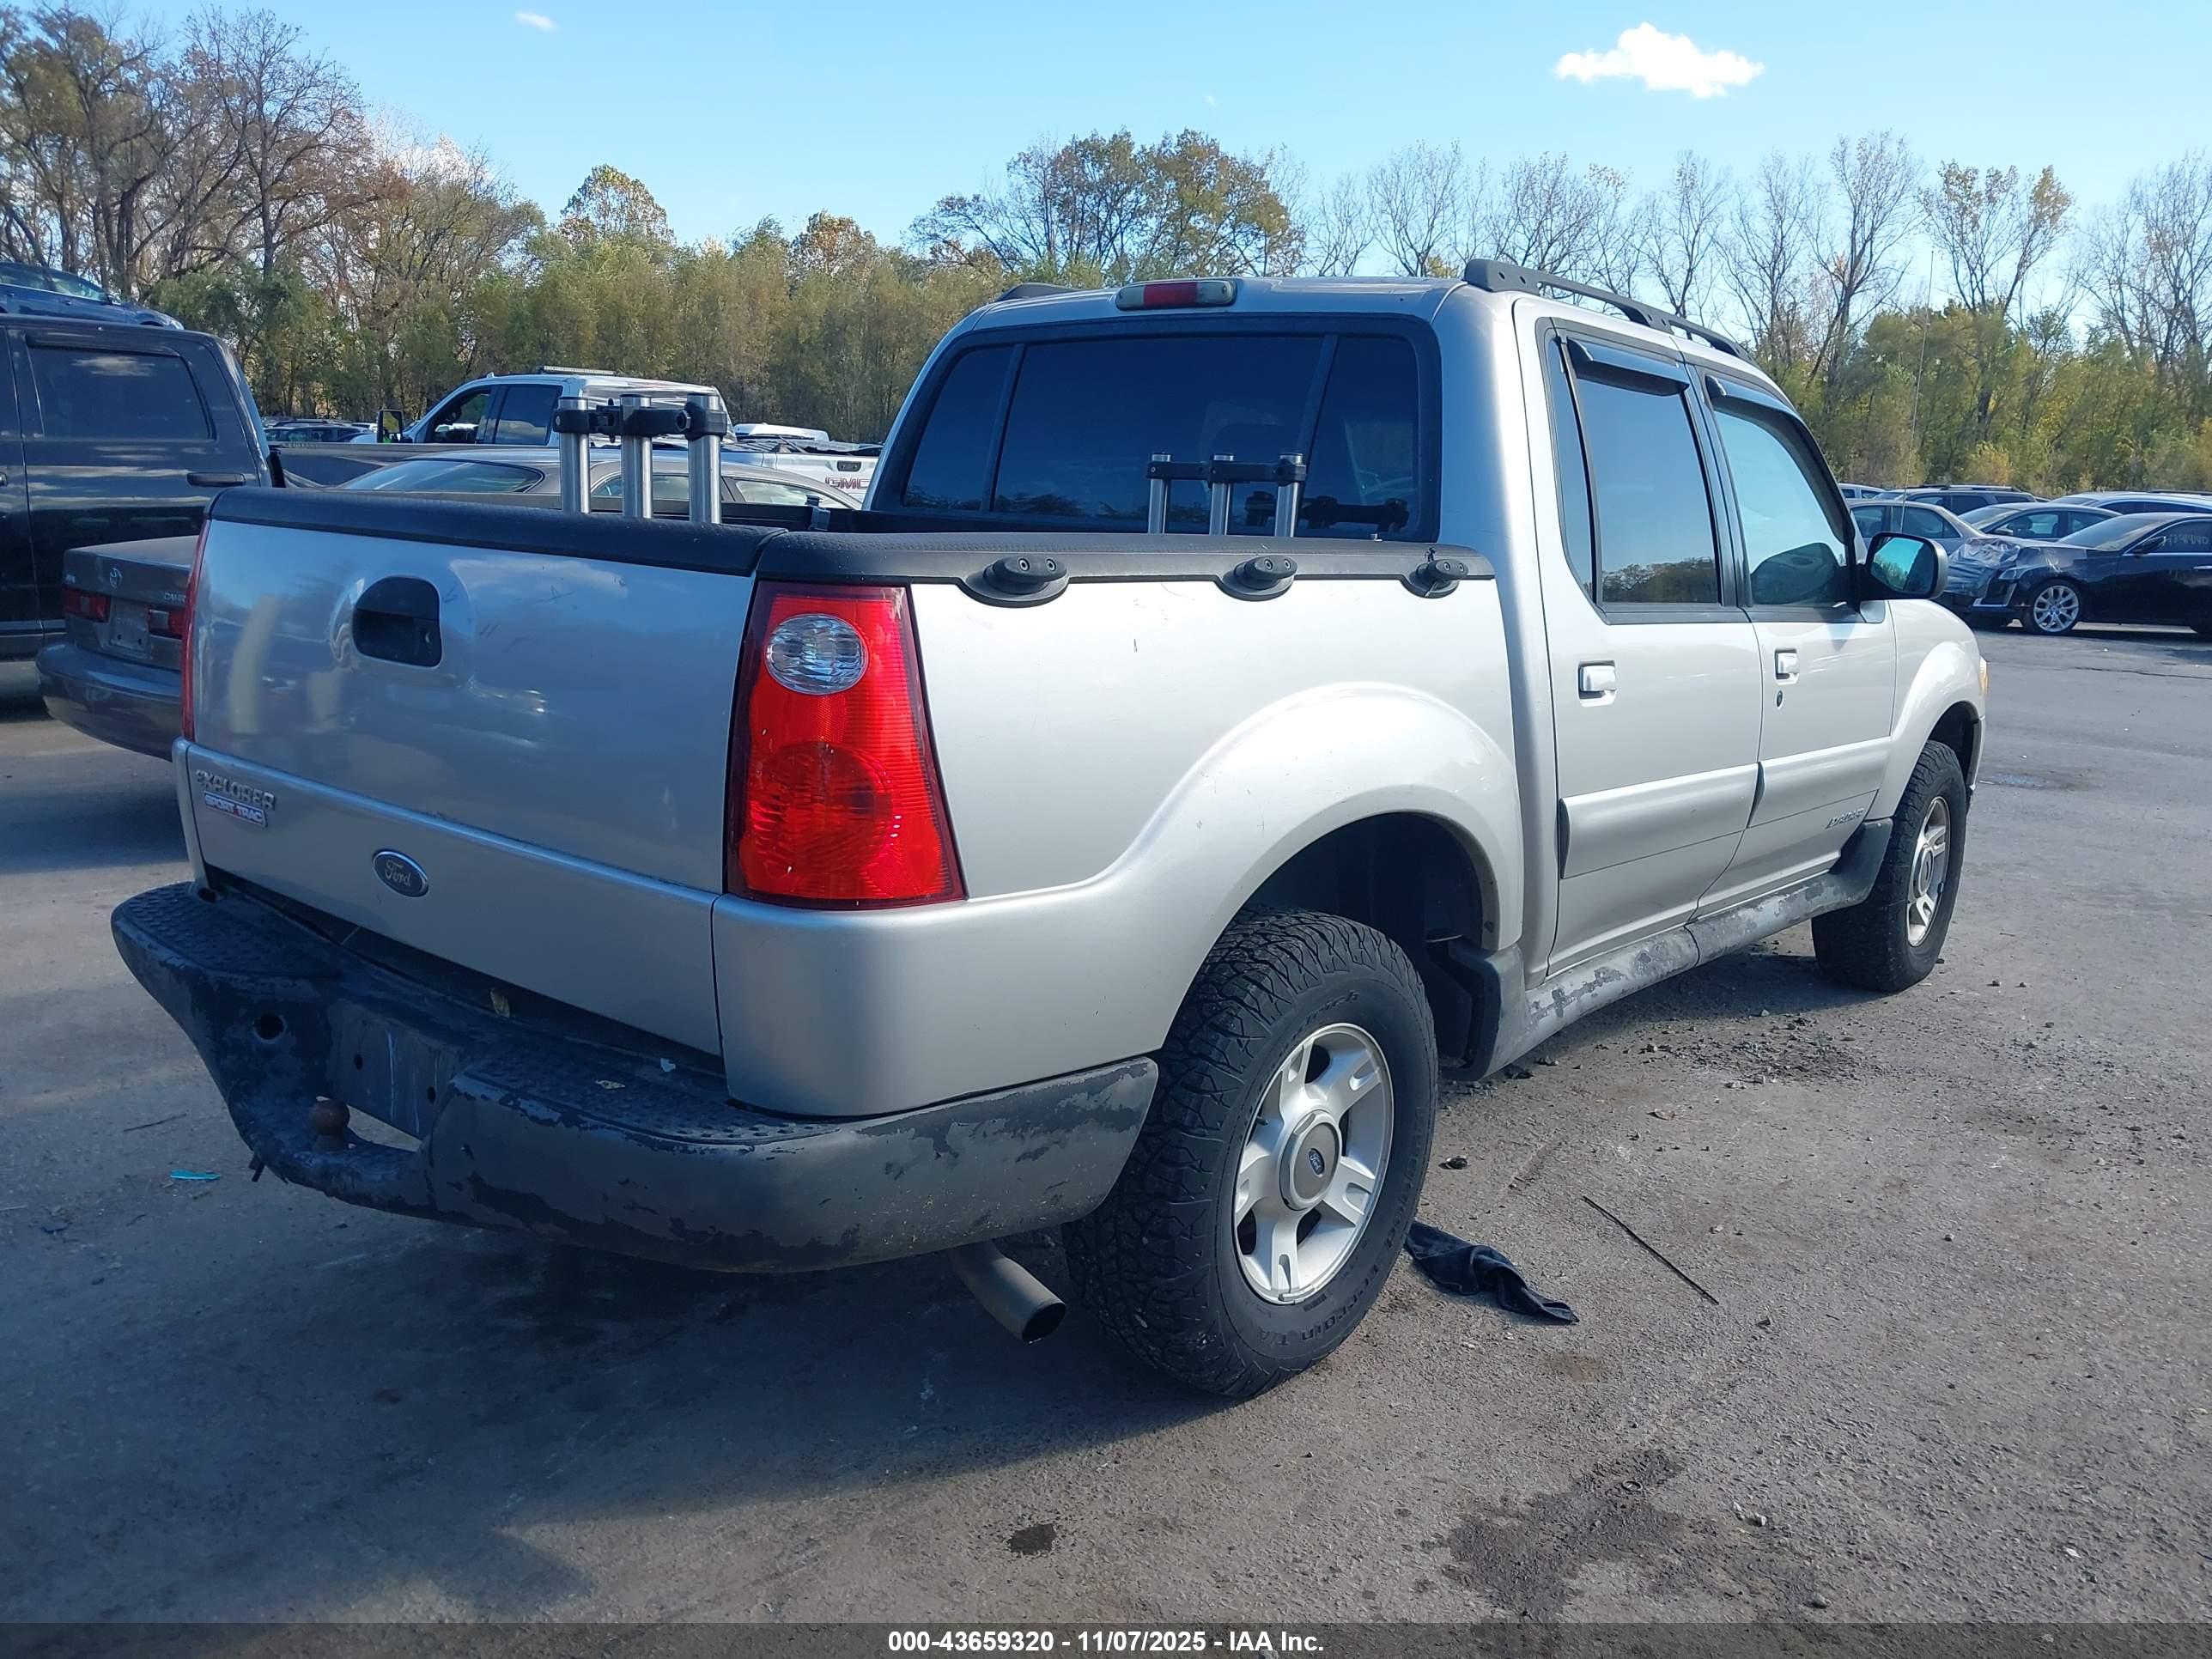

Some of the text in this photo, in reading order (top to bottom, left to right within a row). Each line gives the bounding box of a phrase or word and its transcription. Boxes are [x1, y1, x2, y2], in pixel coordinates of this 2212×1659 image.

[825, 476, 871, 489] GMC
[196, 769, 276, 811] EXPLORER
[205, 793, 264, 823] SPORT TRAC
[385, 860, 411, 886] Ford
